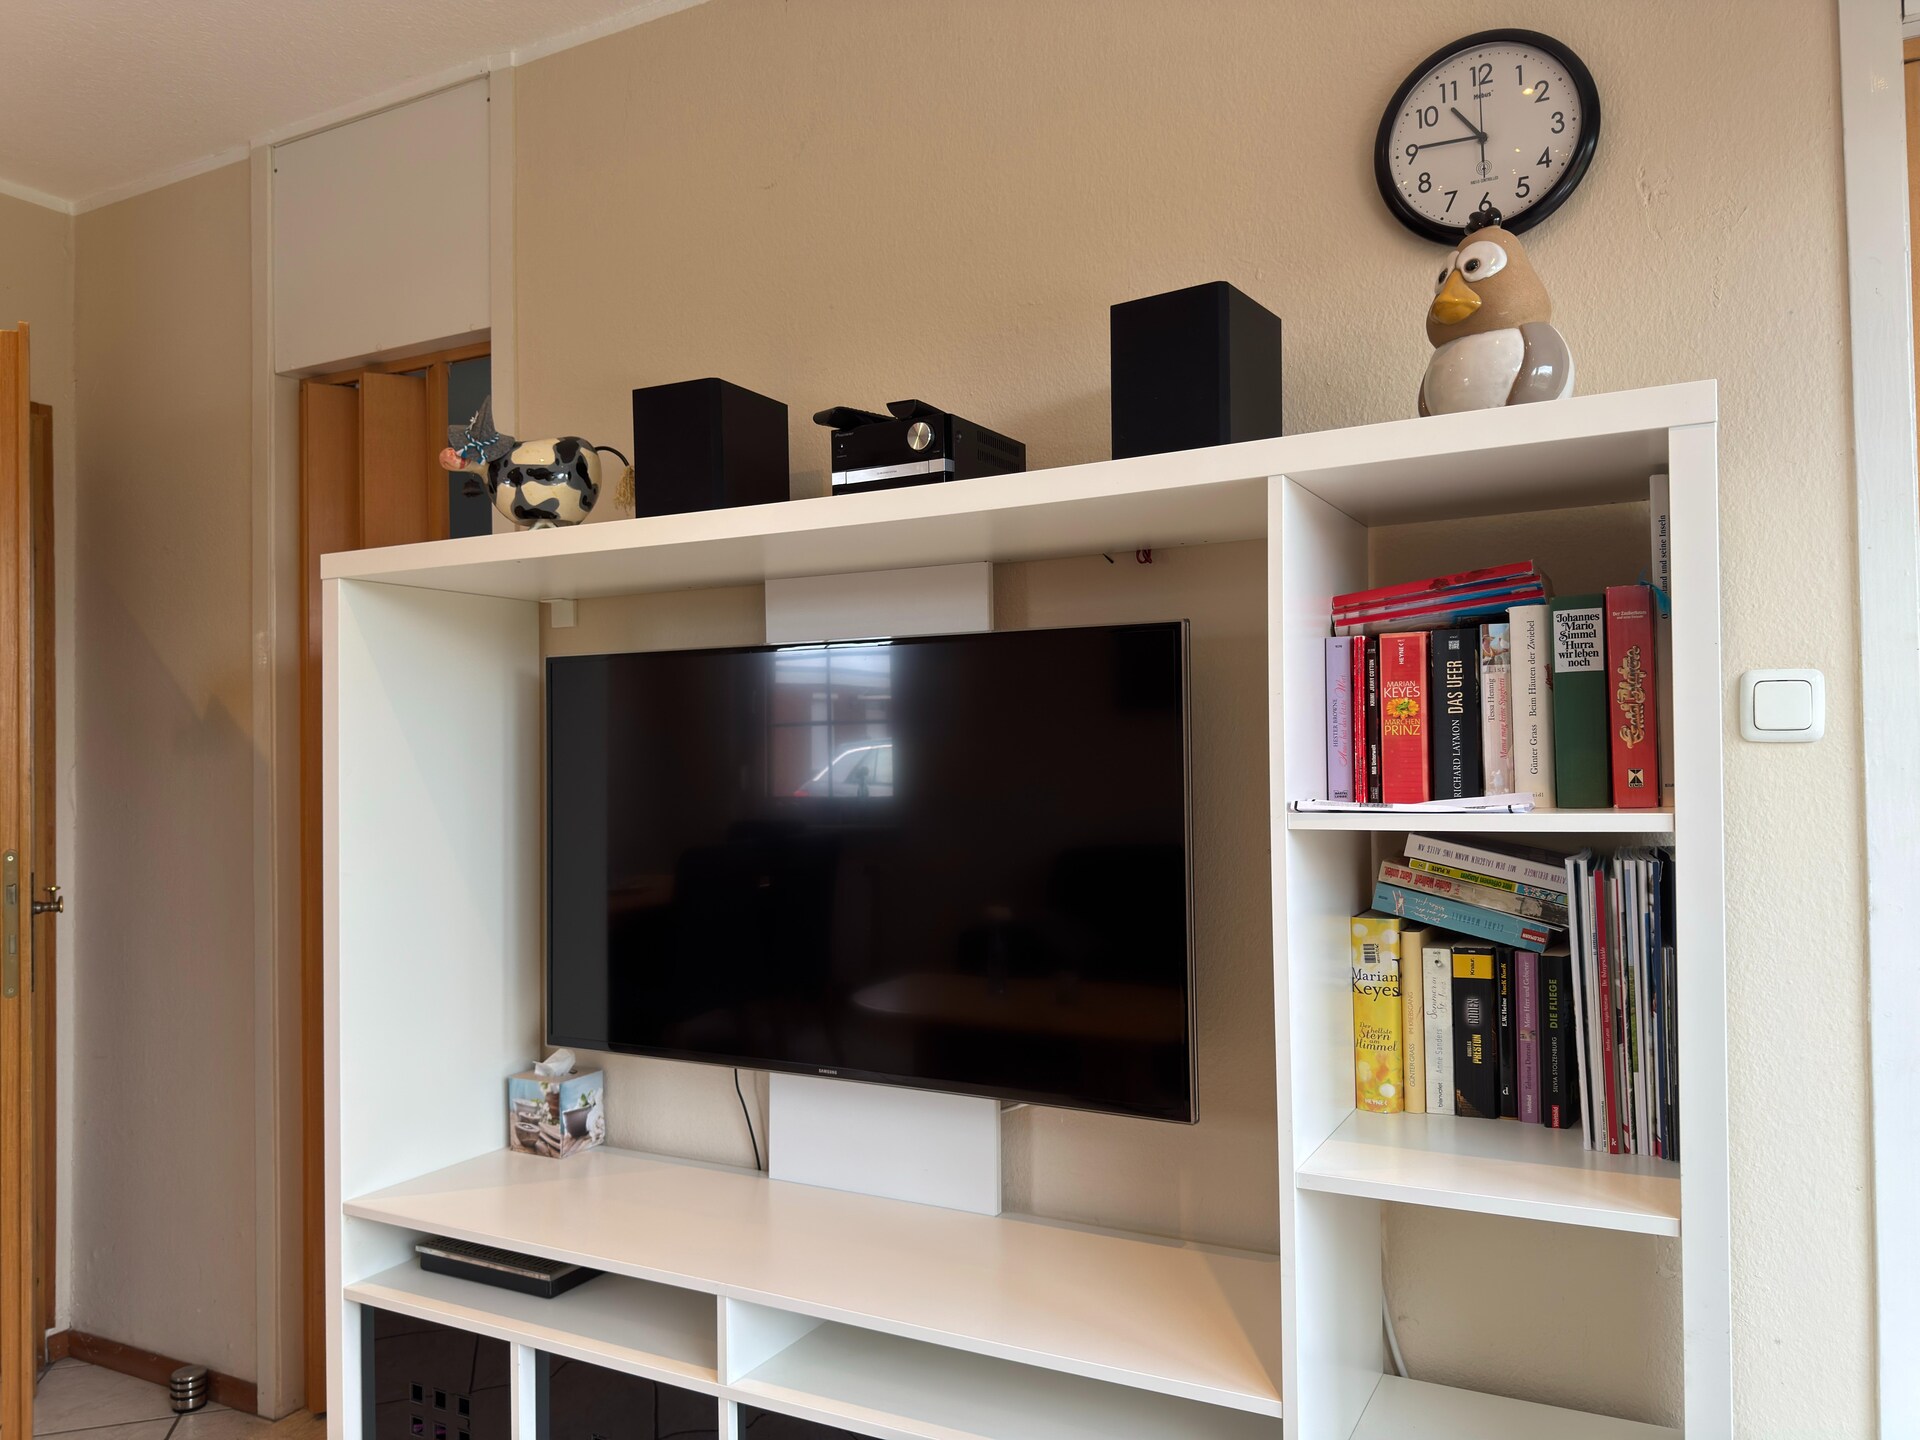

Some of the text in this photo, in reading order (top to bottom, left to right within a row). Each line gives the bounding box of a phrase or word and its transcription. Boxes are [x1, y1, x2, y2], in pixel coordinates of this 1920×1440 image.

[1470, 63, 1493, 87] 12
[1515, 65, 1522, 86] 1
[1439, 80, 1458, 103] 11
[1534, 80, 1550, 103] 2
[1416, 106, 1438, 128] 10
[1551, 112, 1564, 134] 3
[1406, 144, 1418, 165] 9
[1536, 146, 1552, 168] 4
[1418, 172, 1432, 193] 8
[1515, 176, 1530, 198] 5
[1444, 190, 1458, 212] 7
[1478, 192, 1492, 212] 6
[1658, 514, 1666, 536] Inseln
[1556, 613, 1600, 623] Johannes
[1562, 621, 1594, 630] Mario
[1527, 620, 1535, 650] Zwiebel
[1559, 630, 1596, 641] Simmel
[1562, 641, 1594, 649] Hurra
[1558, 649, 1599, 658] wir leben
[1568, 658, 1590, 667] noch
[1446, 661, 1463, 688] UFER
[1528, 667, 1536, 695] Häuten
[1384, 686, 1420, 698] KEYES
[1447, 692, 1463, 714] DAS
[1528, 697, 1536, 716] Beim
[1385, 725, 1420, 736] PRINZ
[1452, 719, 1460, 756] LAYMON
[1500, 724, 1508, 737] mag
[1530, 748, 1538, 774] Günter
[1453, 758, 1461, 797] RICHARD
[1418, 844, 1424, 852] AN
[1455, 850, 1470, 861] MANN
[1471, 853, 1494, 867] FALSCHEN
[1495, 858, 1506, 870] DEM
[1508, 861, 1516, 873] MIT
[1352, 967, 1398, 981] Marian
[1352, 977, 1400, 1002] Keyes
[1548, 979, 1557, 1010] FLIEGE
[1409, 1027, 1414, 1035] IM
[1549, 1014, 1558, 1028] DIE
[1359, 1028, 1391, 1040] Stern
[1356, 1039, 1397, 1051] Himmel
[1472, 1034, 1482, 1064] PRESTON
